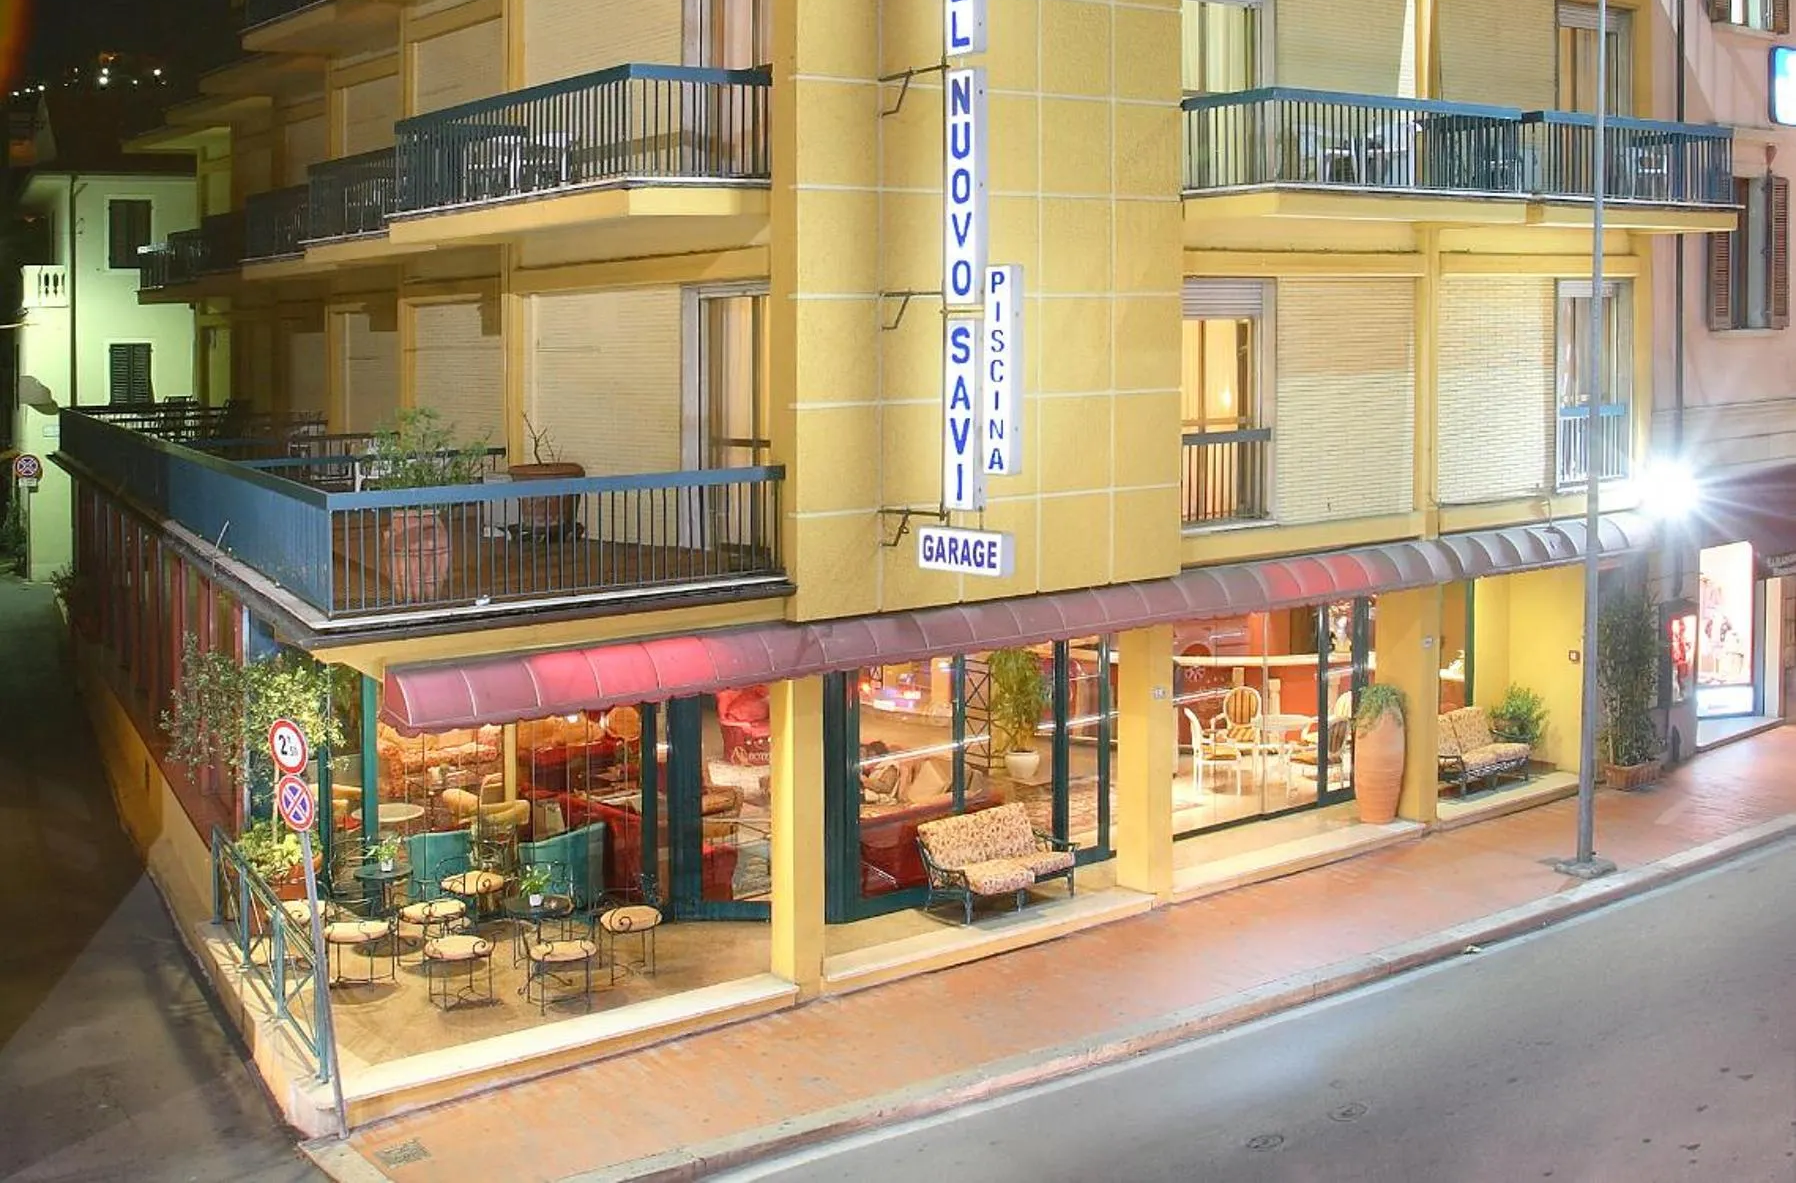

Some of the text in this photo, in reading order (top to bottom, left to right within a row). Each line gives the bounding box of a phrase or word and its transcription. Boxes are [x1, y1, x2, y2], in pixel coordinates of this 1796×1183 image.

[951, 75, 972, 296] NUOVO
[950, 326, 971, 502] SAVI
[988, 271, 1005, 470] PISCINA
[922, 534, 997, 569] GARAGE
